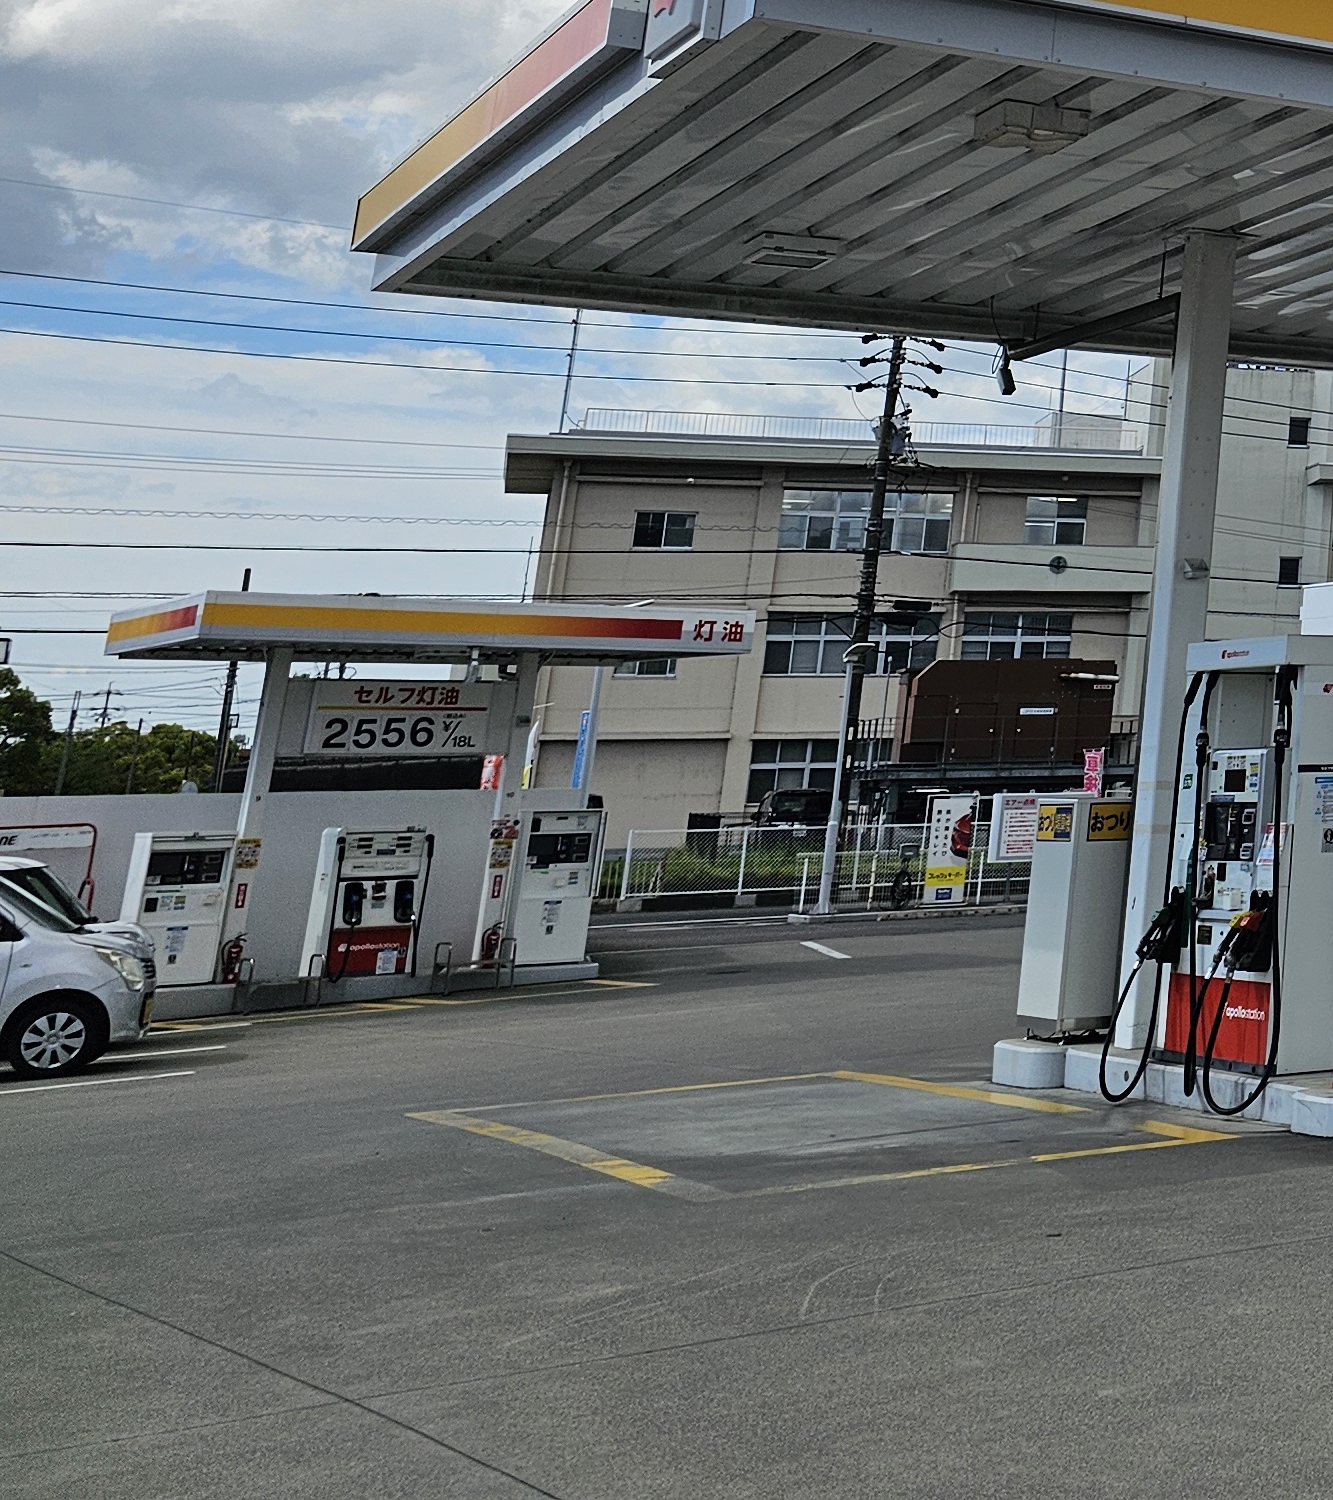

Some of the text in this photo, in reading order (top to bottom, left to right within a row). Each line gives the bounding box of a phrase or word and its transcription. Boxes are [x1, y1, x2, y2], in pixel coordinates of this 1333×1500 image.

[692, 619, 744, 644] 灯油
[354, 685, 460, 707] セルフ灯油
[321, 716, 435, 750] 2556
[1090, 810, 1131, 833] おつり
[1226, 1005, 1266, 1021] apollostation
